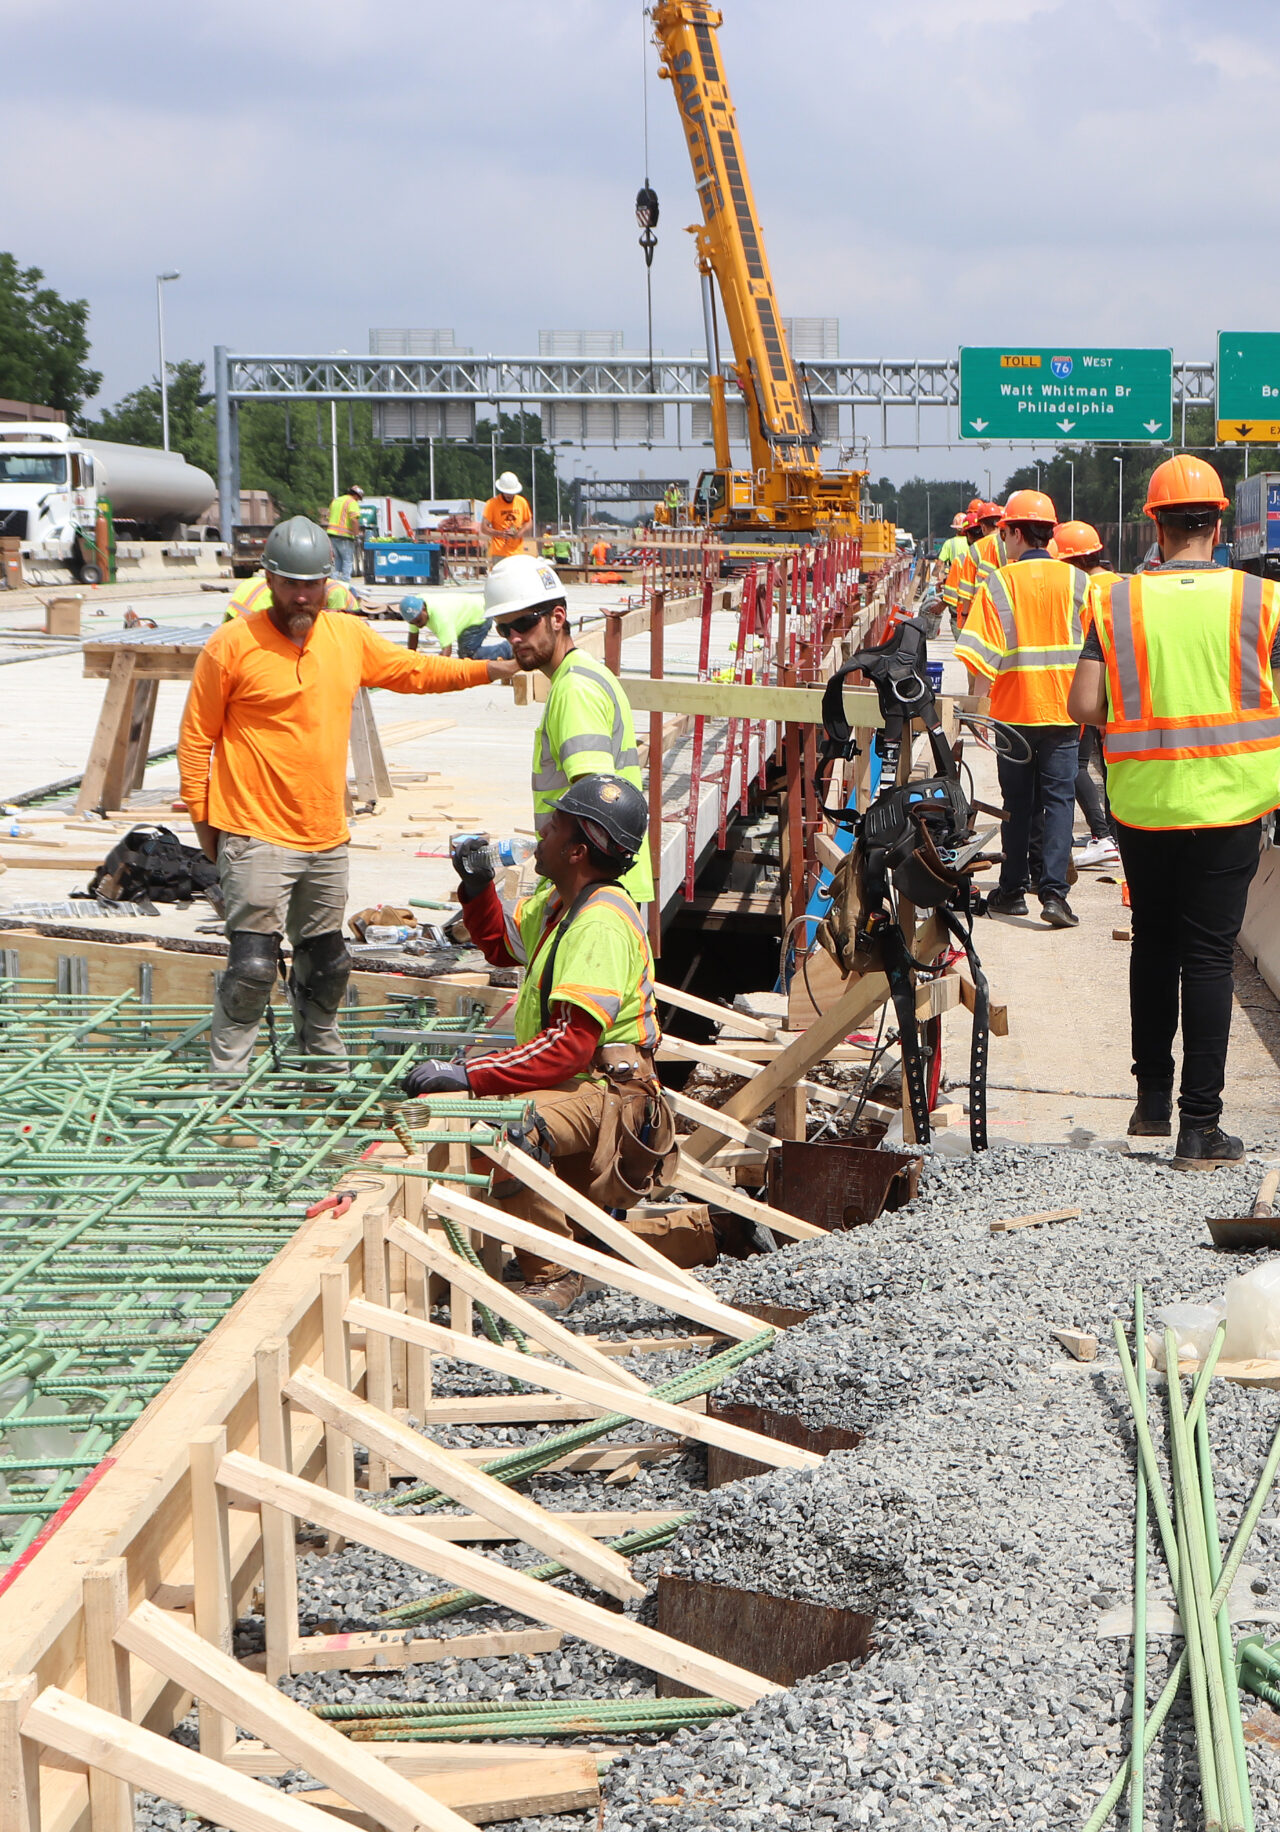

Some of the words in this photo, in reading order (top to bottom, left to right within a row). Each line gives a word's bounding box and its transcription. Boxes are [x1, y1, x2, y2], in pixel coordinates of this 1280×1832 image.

[1004, 356, 1037, 367] TOLL
[1054, 362, 1070, 374] 76
[1082, 356, 1113, 367] WEST
[1000, 384, 1033, 396] Walt
[1041, 384, 1108, 397] Whitman
[1115, 385, 1132, 397] Br
[1018, 401, 1114, 415] Philadelphia
